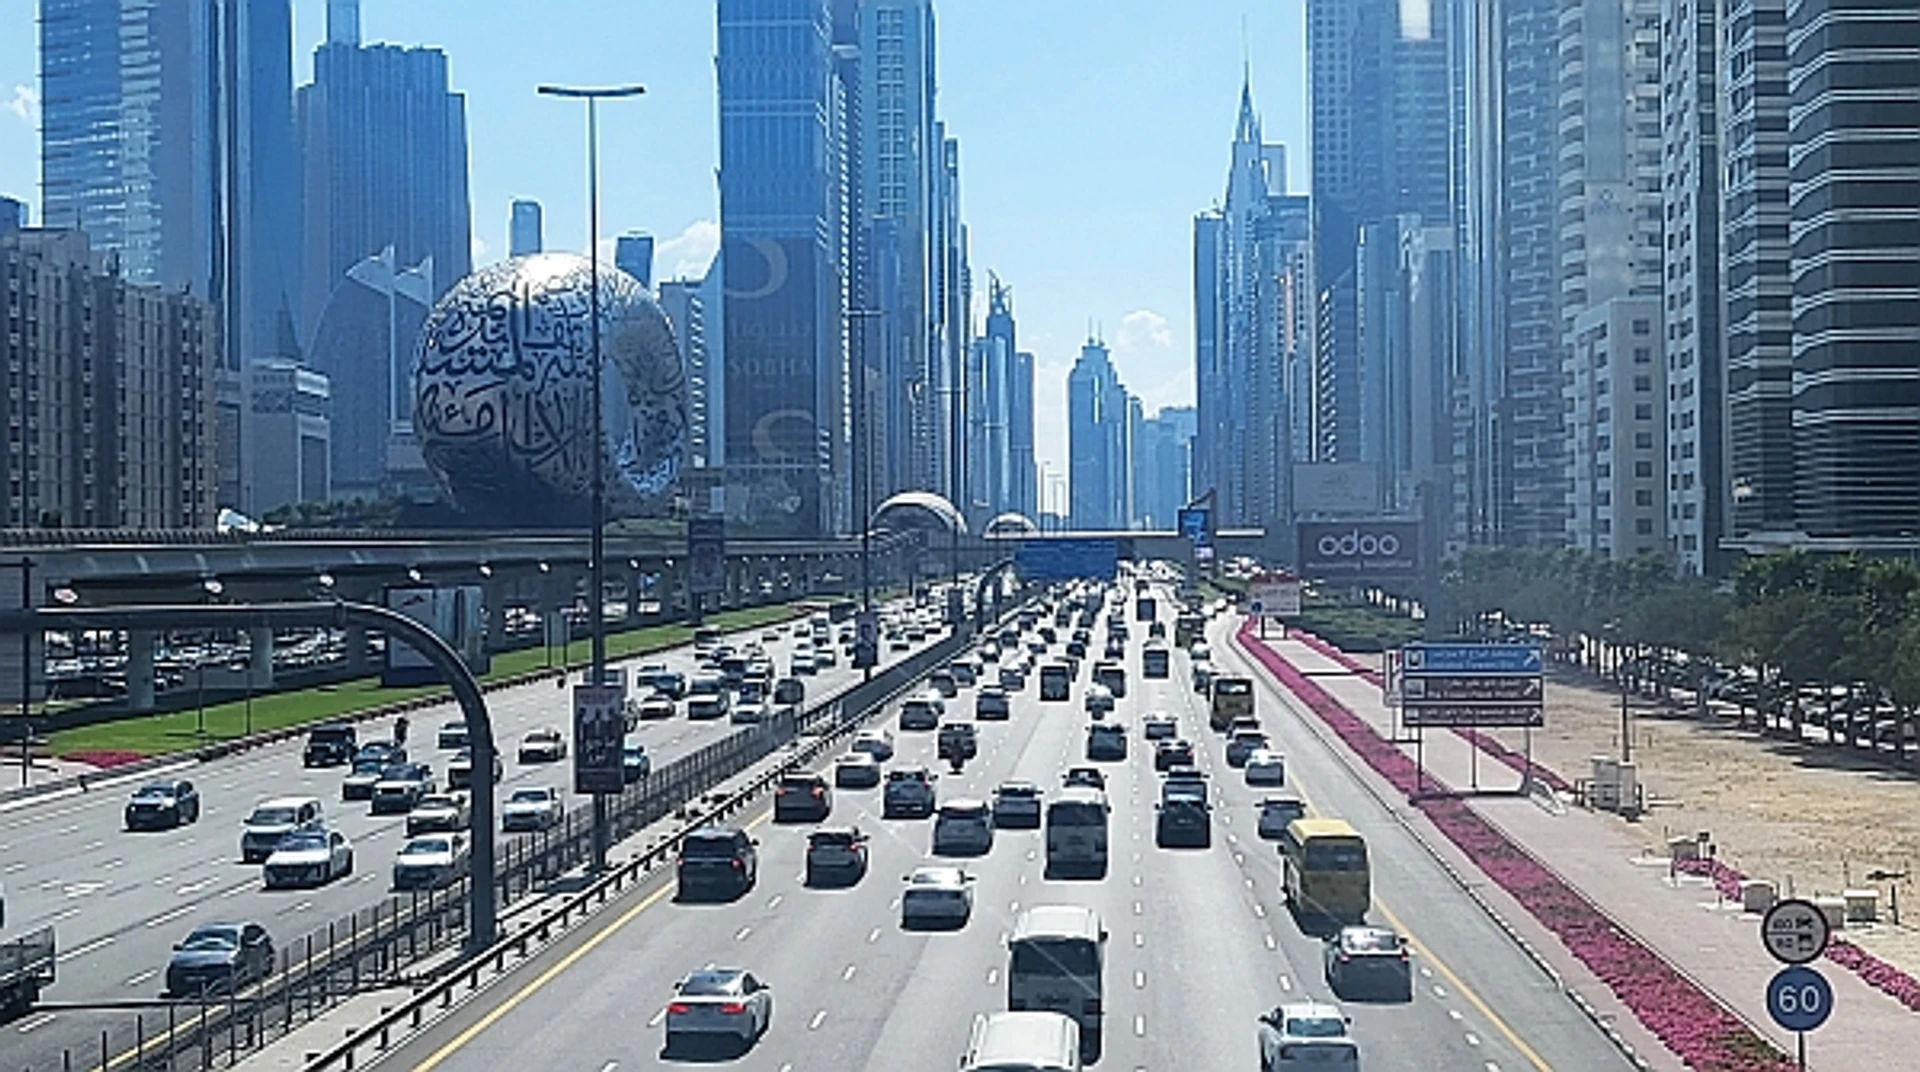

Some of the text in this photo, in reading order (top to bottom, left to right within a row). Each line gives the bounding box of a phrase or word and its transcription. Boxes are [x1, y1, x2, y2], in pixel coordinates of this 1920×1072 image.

[728, 356, 813, 376] SOBHA
[1318, 528, 1400, 555] odoo
[1779, 986, 1819, 1012] 60
